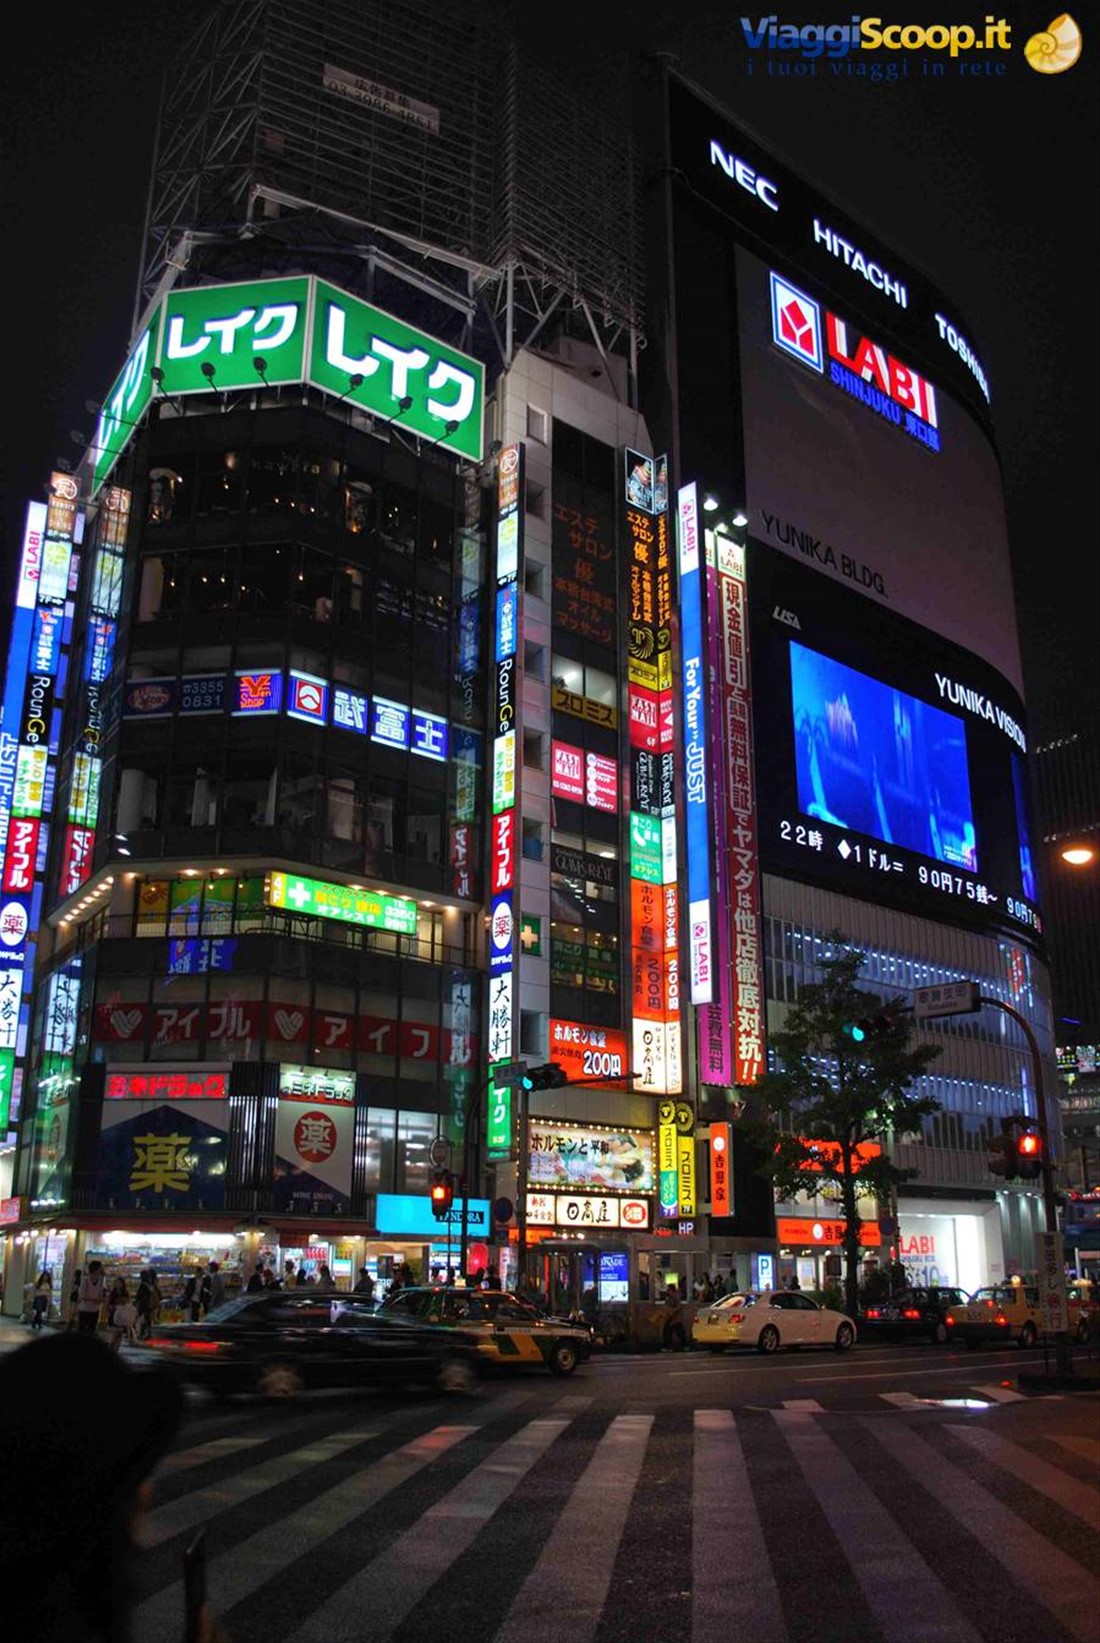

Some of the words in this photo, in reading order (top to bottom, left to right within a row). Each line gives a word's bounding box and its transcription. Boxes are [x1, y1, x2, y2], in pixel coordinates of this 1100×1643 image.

[710, 139, 780, 213] NEC
[813, 218, 908, 310] HITACHI
[165, 303, 299, 360] レイク
[325, 302, 476, 423] レイク
[826, 310, 938, 429] LABI
[830, 360, 902, 426] SHINJUKU
[26, 531, 42, 563] LABI
[684, 516, 698, 552] LABI
[761, 511, 838, 569] YUNIKA
[842, 556, 888, 597] BLDG.
[686, 657, 700, 687] For
[934, 672, 997, 725] YUNIKA
[26, 675, 51, 744] RounGe
[334, 691, 444, 754] 武富士
[499, 659, 514, 739] RounGe
[556, 690, 614, 725] プロミス
[10, 820, 33, 888] アイフル
[497, 818, 511, 887] アイフル
[780, 821, 823, 852] 22時
[698, 941, 710, 985] LABI
[157, 1006, 252, 1039] アイフル
[492, 979, 512, 1056] 大勝軒
[583, 1050, 621, 1077] 200円
[298, 1116, 333, 1154] 薬
[128, 1131, 193, 1194] 薬
[681, 1151, 692, 1201] プロミス
[566, 1200, 612, 1224] 日高屋
[679, 1222, 694, 1235] HP
[761, 1258, 769, 1275] P
[899, 1234, 935, 1254] LABI
